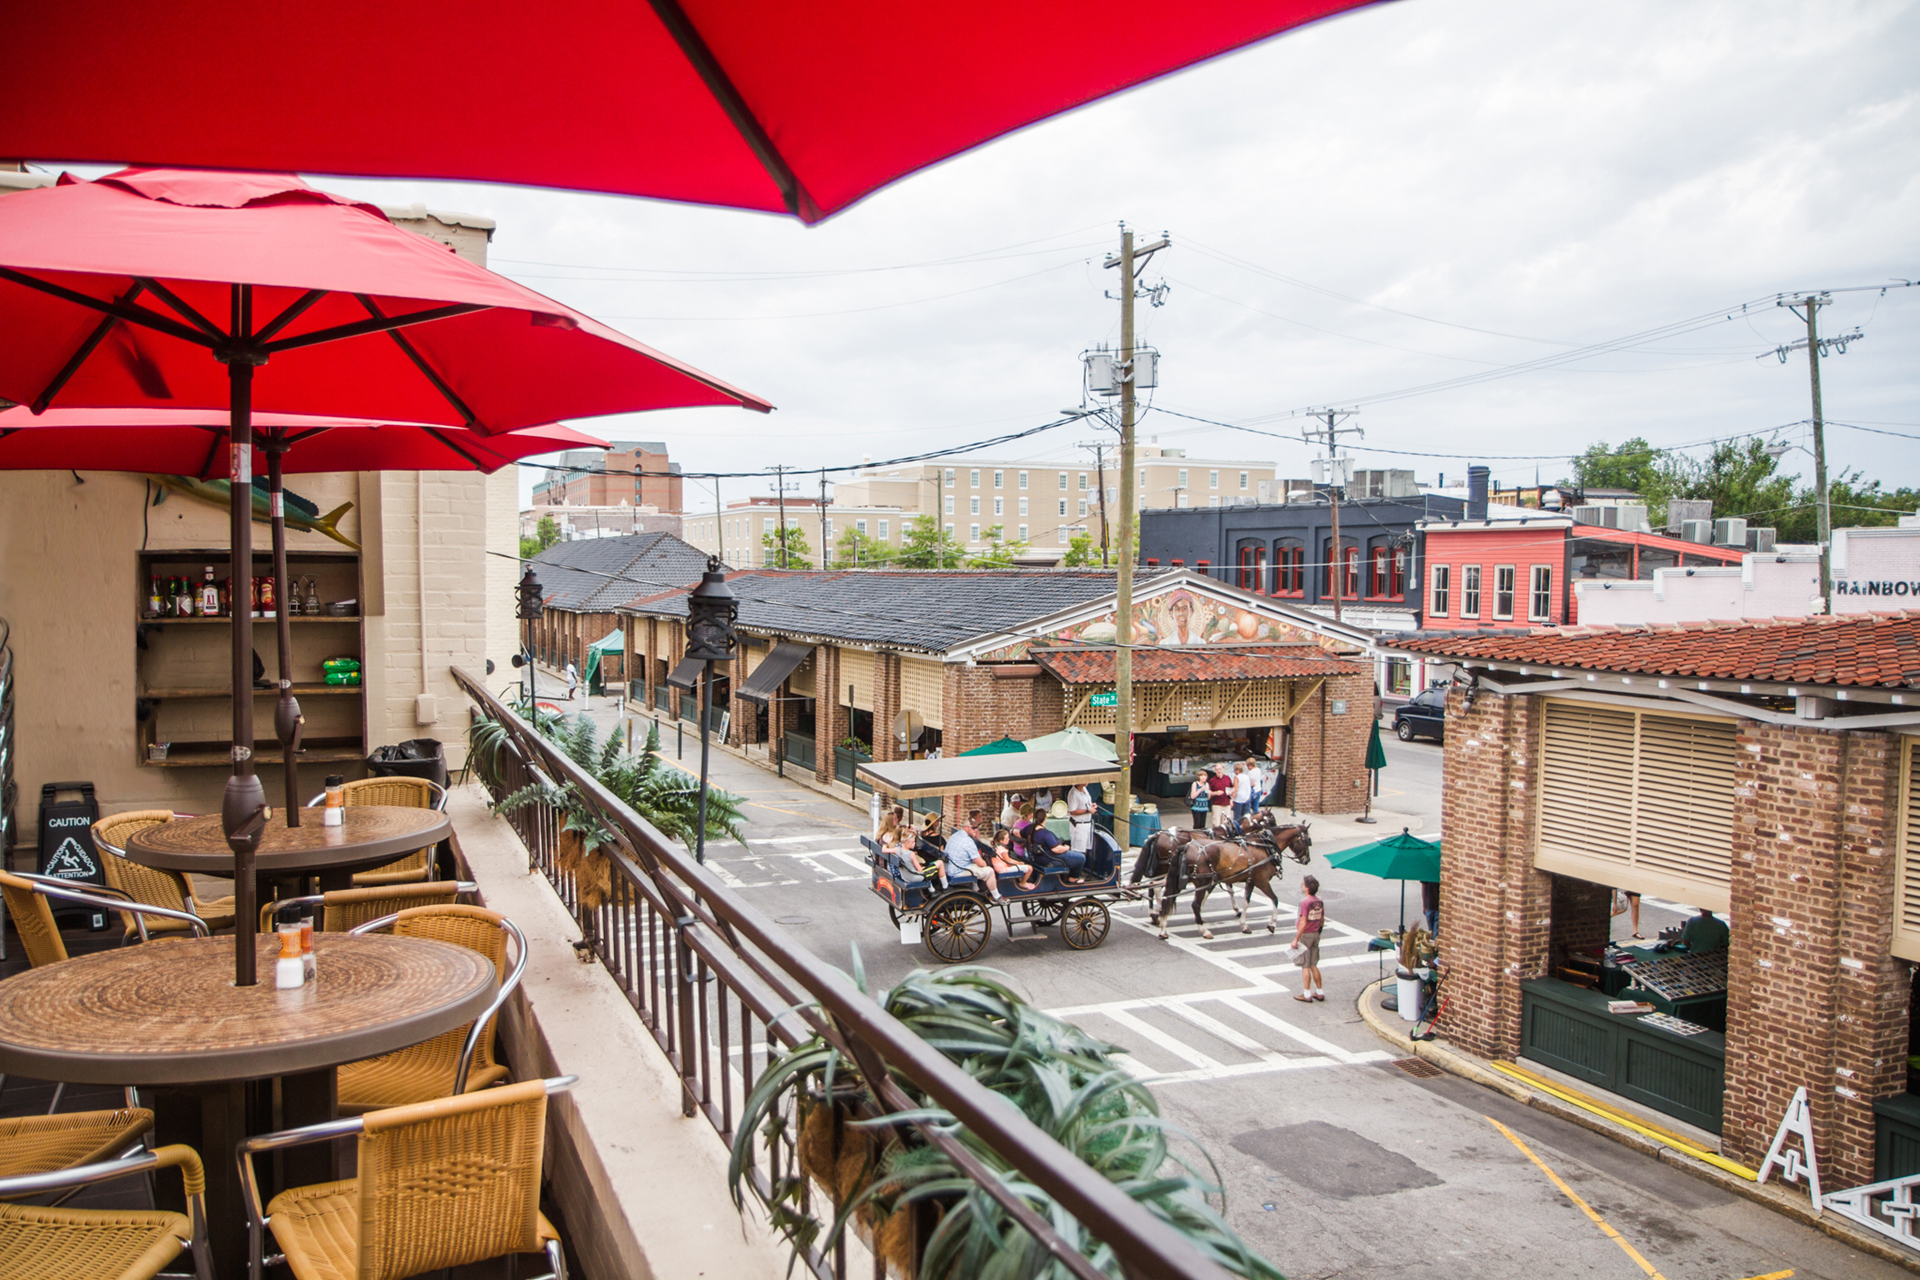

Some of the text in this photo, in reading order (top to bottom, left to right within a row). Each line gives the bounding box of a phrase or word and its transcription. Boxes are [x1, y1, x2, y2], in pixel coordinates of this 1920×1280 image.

[1092, 696, 1110, 705] State
[48, 816, 91, 828] CAUTION
[47, 844, 66, 870] CAUTION
[74, 843, 93, 868] CUIDADO
